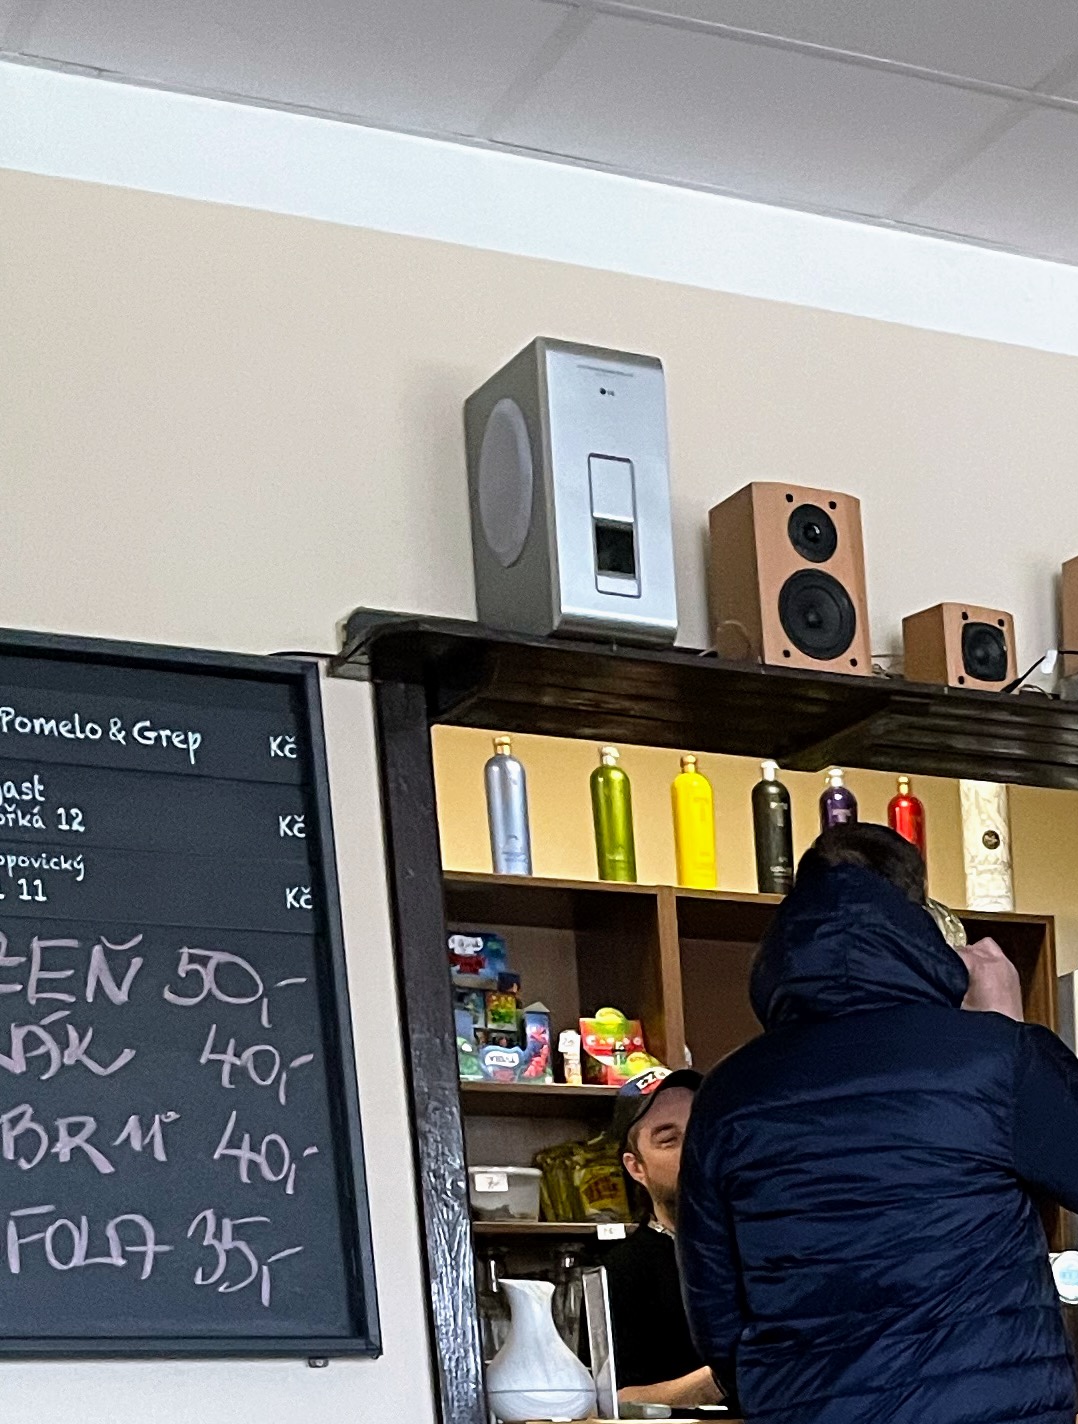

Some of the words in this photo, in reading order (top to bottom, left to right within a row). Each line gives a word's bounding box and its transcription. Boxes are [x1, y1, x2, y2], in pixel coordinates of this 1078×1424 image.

[0, 706, 102, 739] Pomelo
[133, 720, 202, 764] Grep
[269, 735, 297, 759] Kč
[0, 774, 46, 806] ast
[57, 807, 86, 832] 12
[278, 814, 306, 838] Kč
[17, 878, 48, 901] 11
[285, 886, 313, 909] Kč
